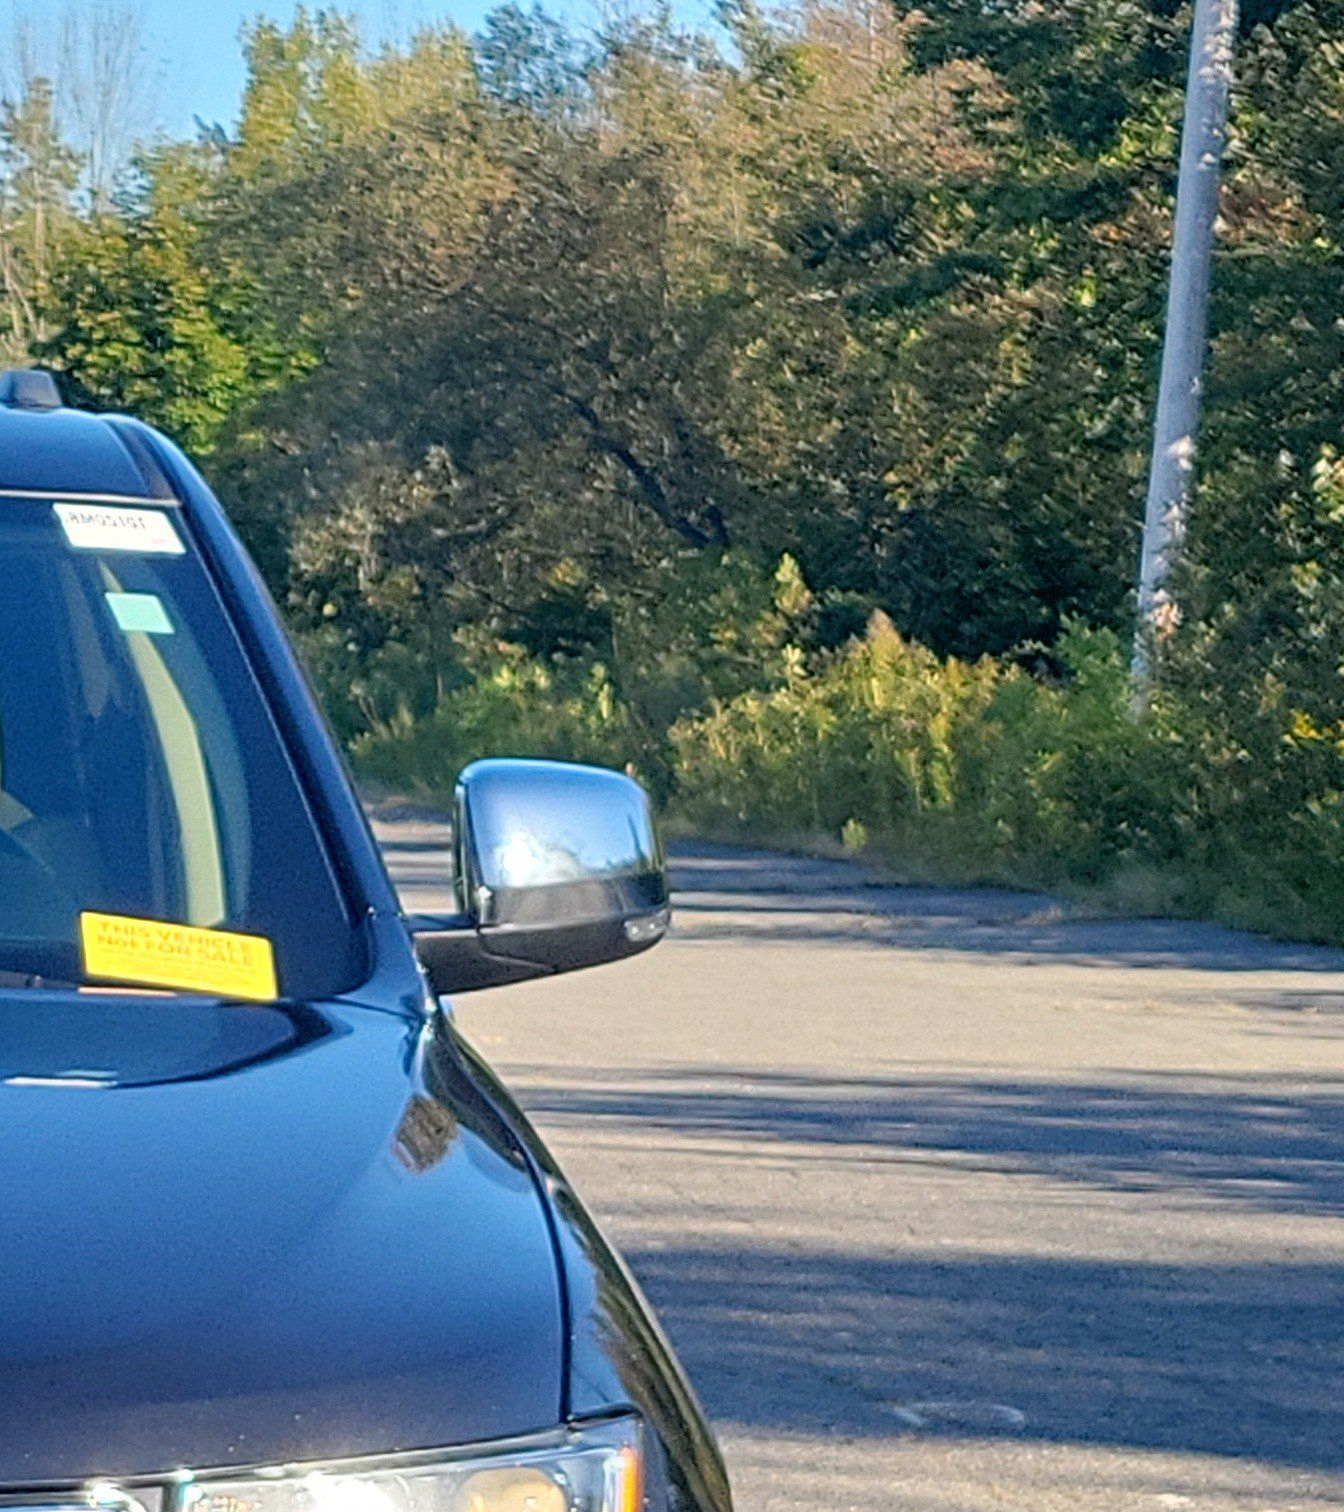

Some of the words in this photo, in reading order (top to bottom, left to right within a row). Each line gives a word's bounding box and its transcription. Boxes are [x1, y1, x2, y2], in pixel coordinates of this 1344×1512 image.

[98, 922, 150, 938] THIS
[157, 930, 252, 953] VEHICLE
[145, 940, 191, 957] FOR
[198, 947, 254, 966] SALE
